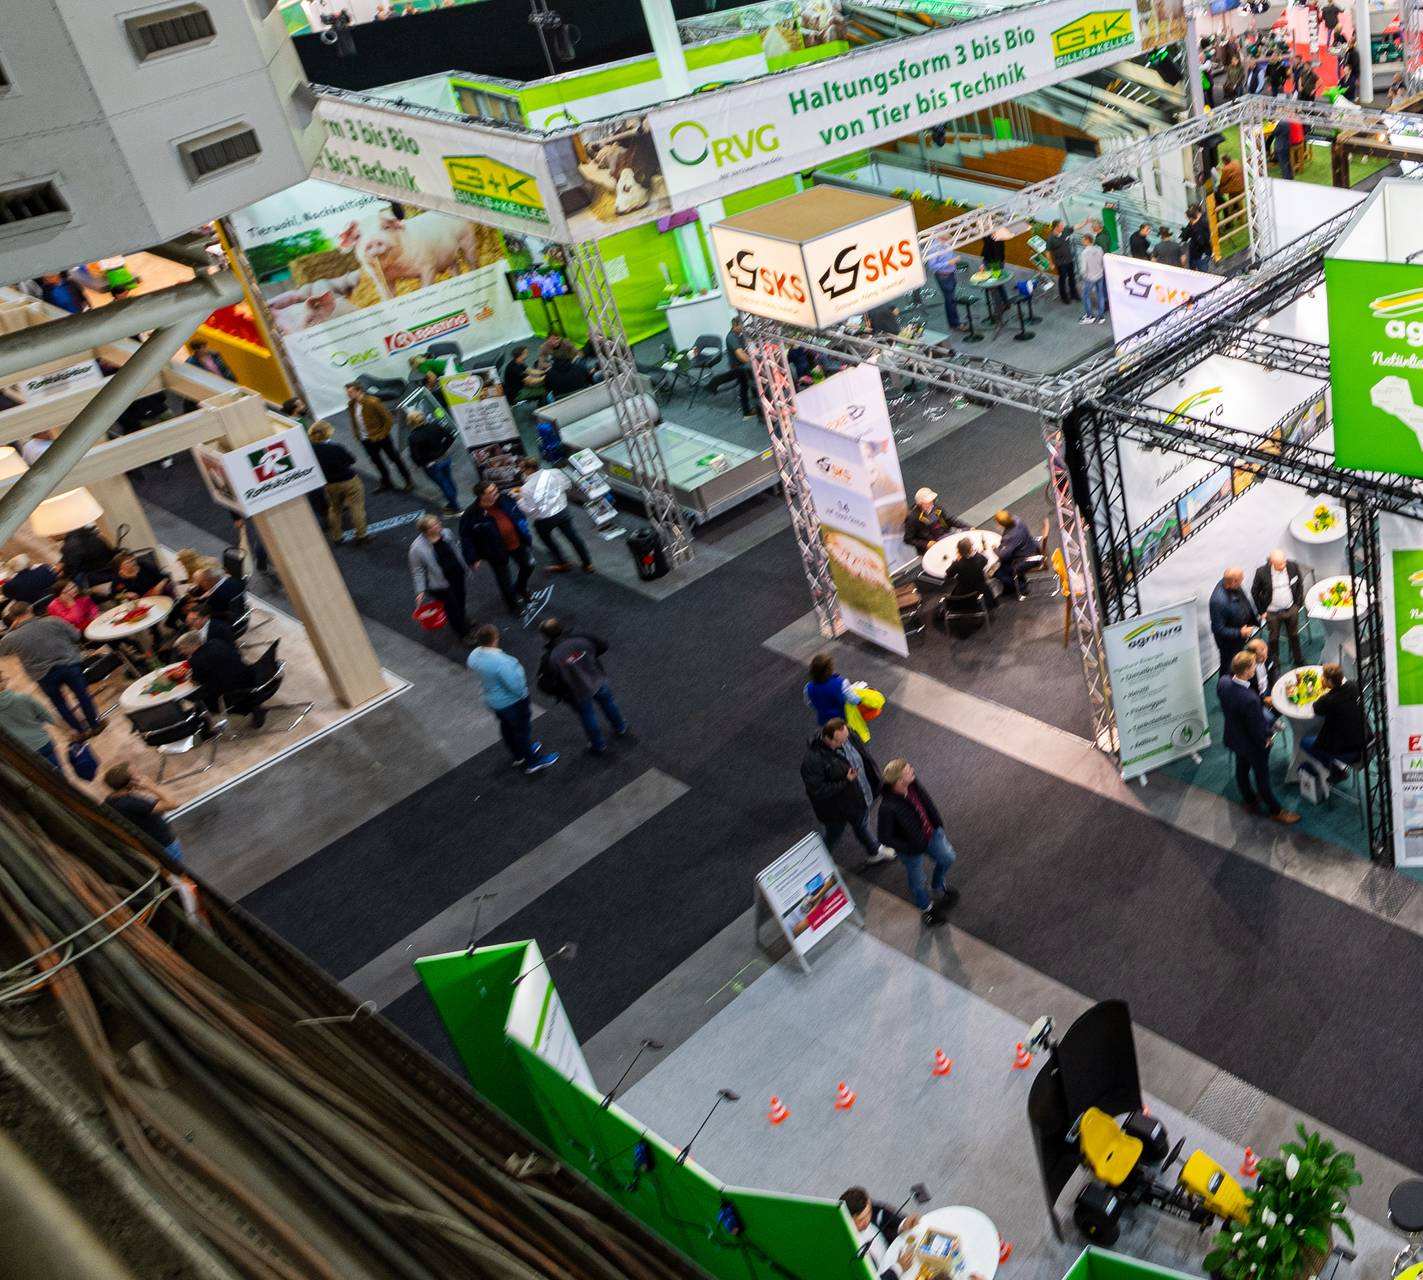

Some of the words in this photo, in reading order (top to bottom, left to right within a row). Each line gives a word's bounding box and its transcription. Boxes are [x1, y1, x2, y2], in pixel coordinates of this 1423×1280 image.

[788, 54, 950, 116] Haltungsform
[956, 44, 968, 66] 3
[971, 34, 1001, 61] bis
[1004, 25, 1036, 52] Bio
[819, 117, 864, 147] von
[866, 99, 911, 131] Tier
[915, 89, 948, 115] bis
[950, 62, 1026, 104] Technik
[357, 119, 388, 148] bis
[387, 127, 420, 155] Bio
[711, 123, 780, 168] RVG
[350, 154, 421, 192] Technik
[863, 240, 914, 282] SKS
[759, 266, 806, 303] SKS
[1127, 624, 1183, 649] agritura
